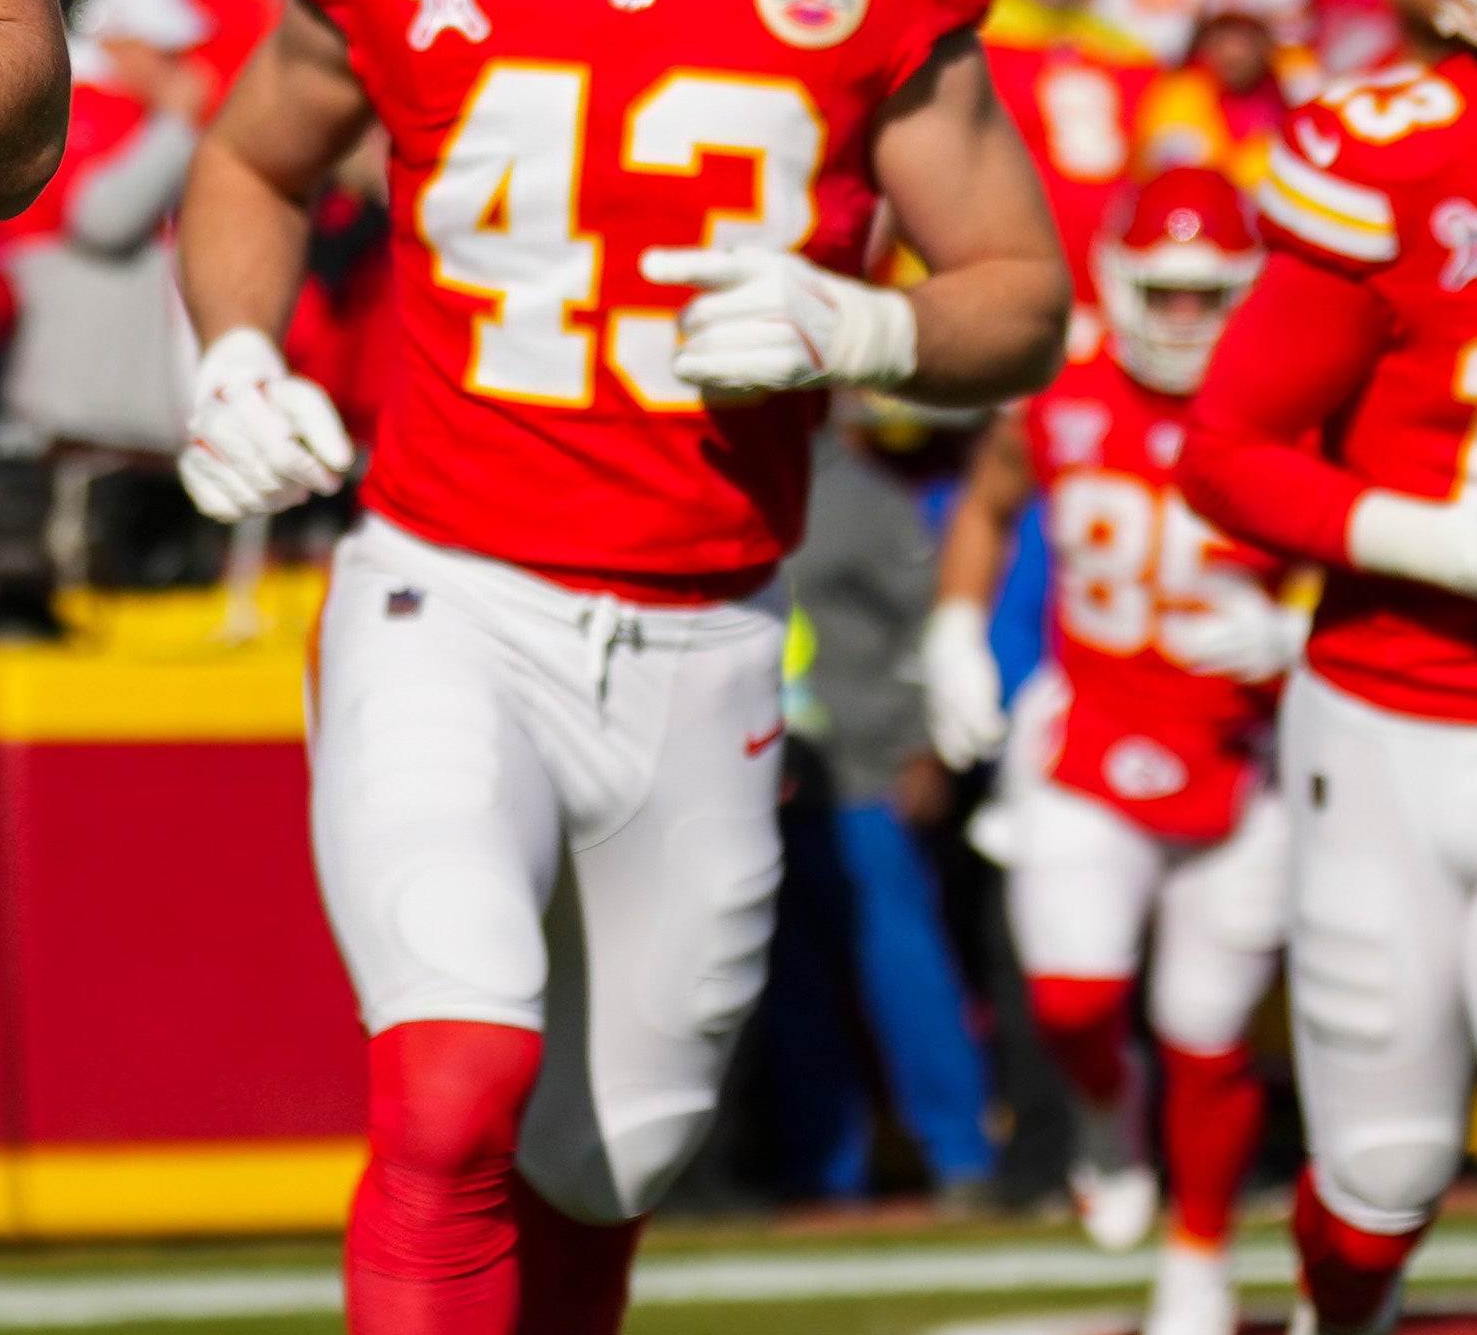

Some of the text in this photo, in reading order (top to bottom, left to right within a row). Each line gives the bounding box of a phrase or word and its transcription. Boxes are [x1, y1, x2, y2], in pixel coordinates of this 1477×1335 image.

[1319, 66, 1467, 148] 3
[417, 58, 829, 412] 43
[1051, 466, 1239, 672] 85
